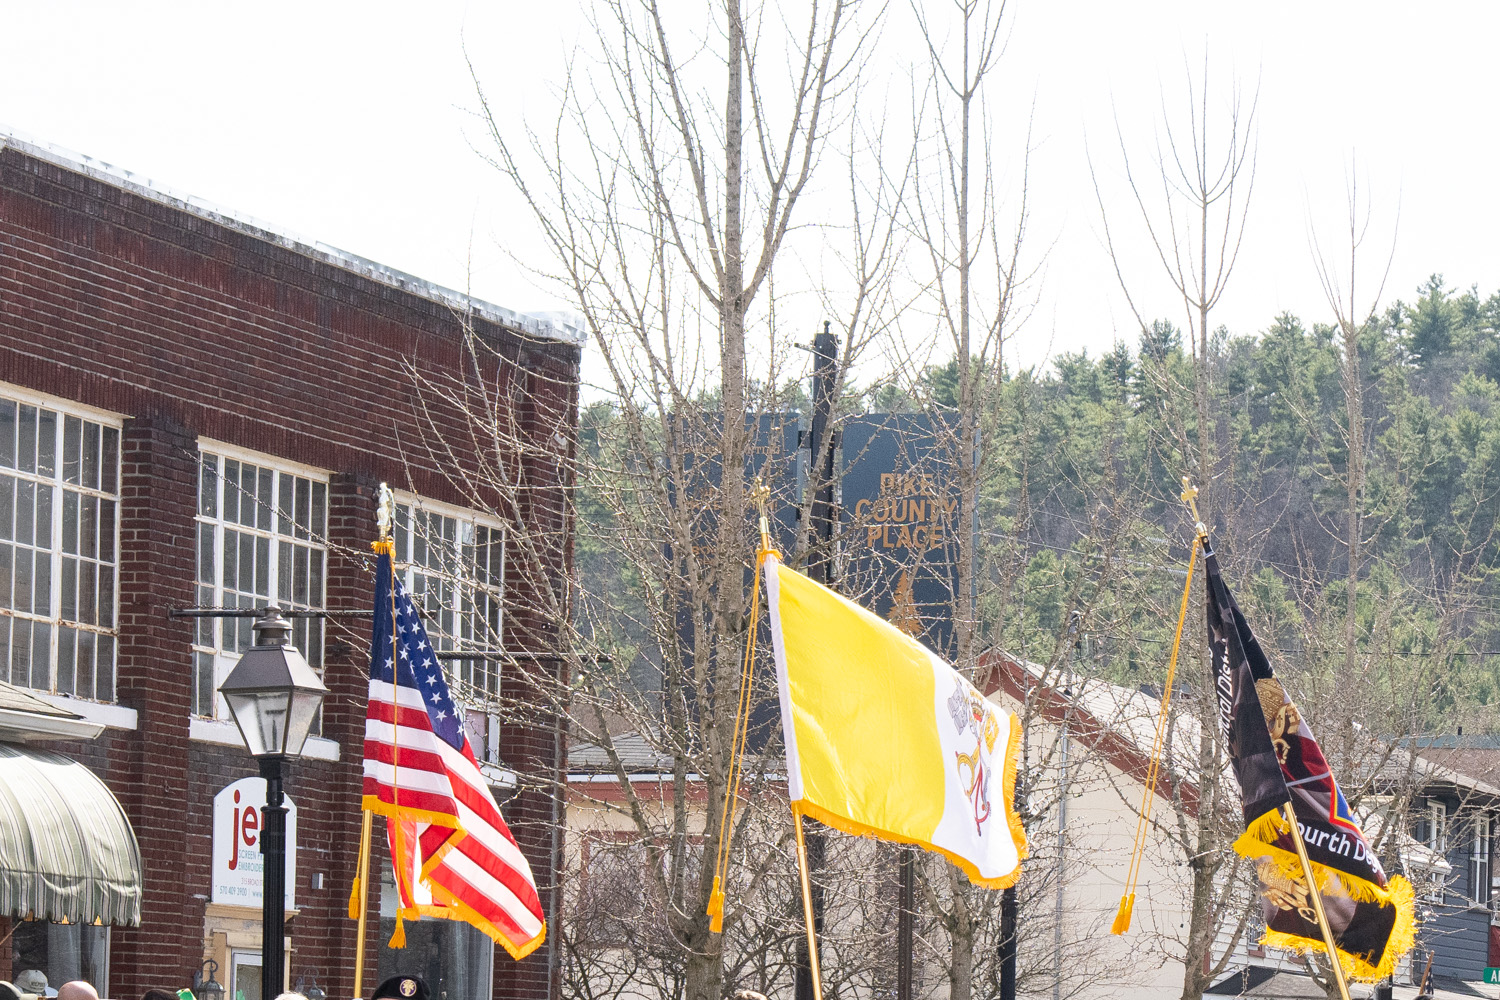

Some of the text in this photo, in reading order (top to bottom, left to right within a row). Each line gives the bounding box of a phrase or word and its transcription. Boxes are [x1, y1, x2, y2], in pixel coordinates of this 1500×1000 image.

[880, 473, 933, 496] PIKE
[855, 498, 957, 522] COUNTY
[867, 525, 943, 549] PLACE
[228, 789, 265, 871] je
